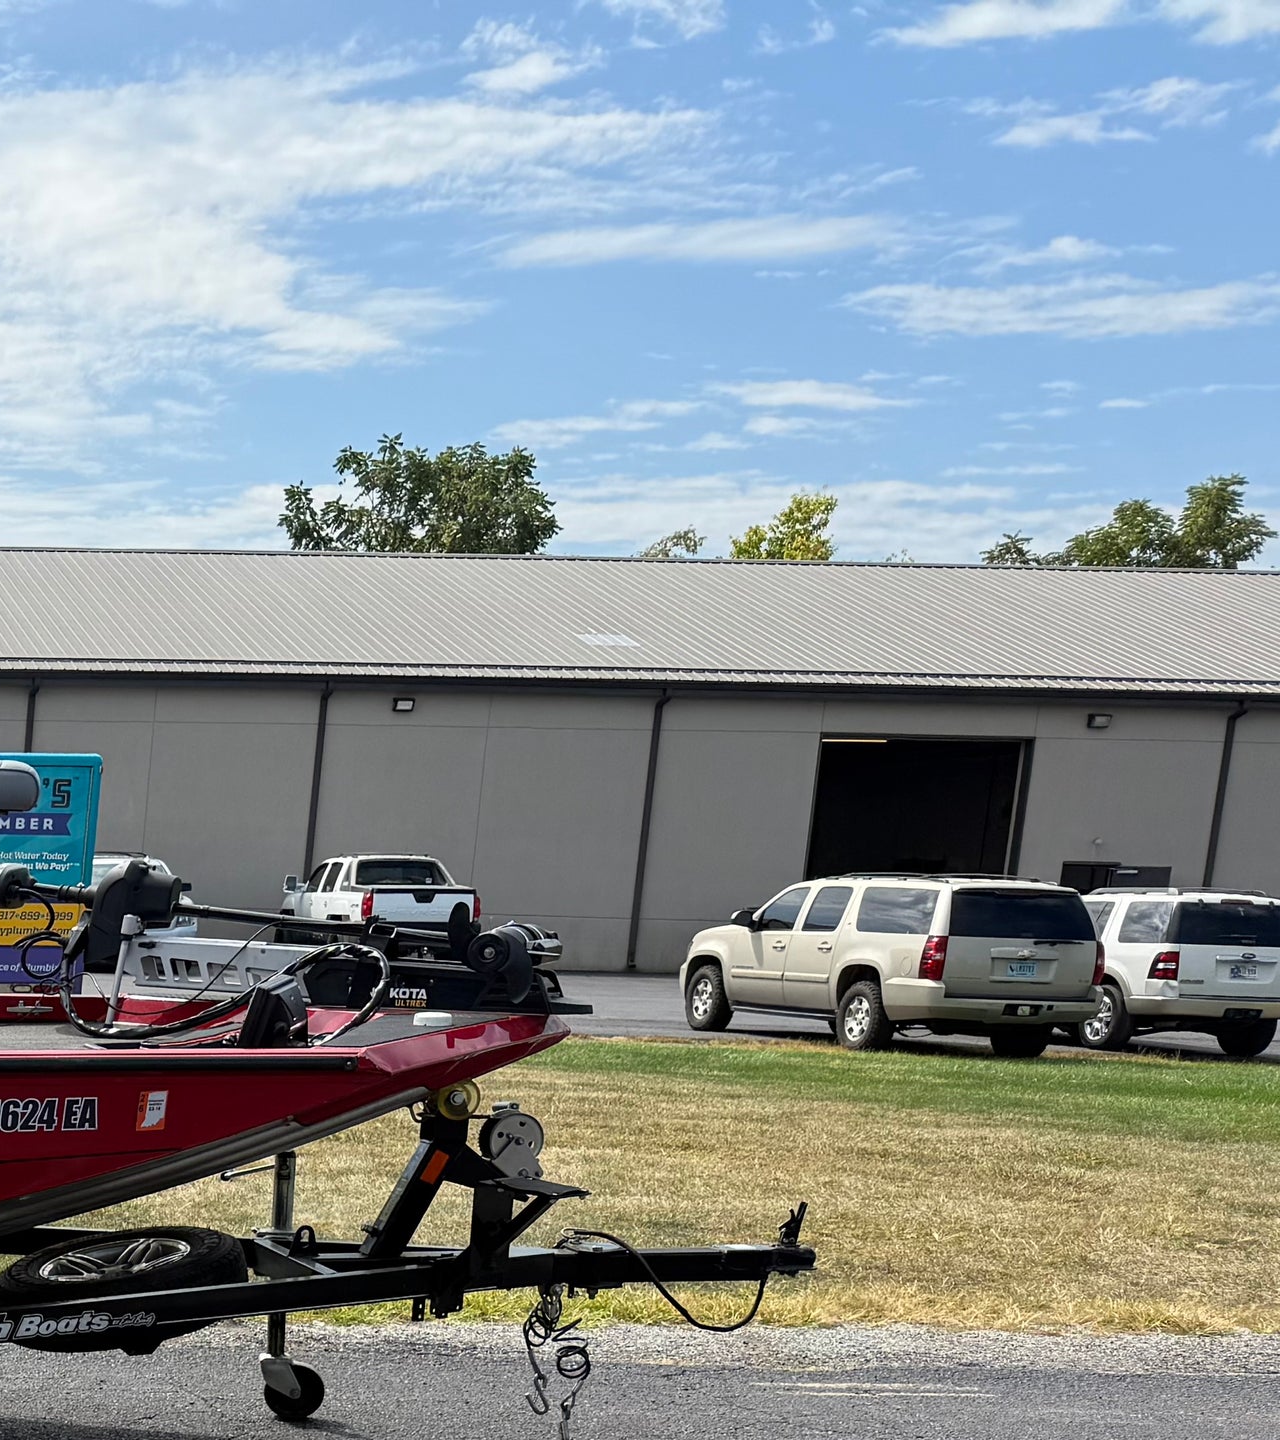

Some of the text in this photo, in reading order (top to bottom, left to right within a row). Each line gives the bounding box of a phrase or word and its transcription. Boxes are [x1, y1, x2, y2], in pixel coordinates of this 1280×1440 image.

[14, 852, 41, 860] Water
[41, 852, 70, 862] Today
[10, 963, 21, 973] of
[389, 987, 428, 999] KOTA
[394, 999, 427, 1008] ULTREX
[61, 1096, 98, 1131] EA
[13, 1311, 112, 1339] Boats
